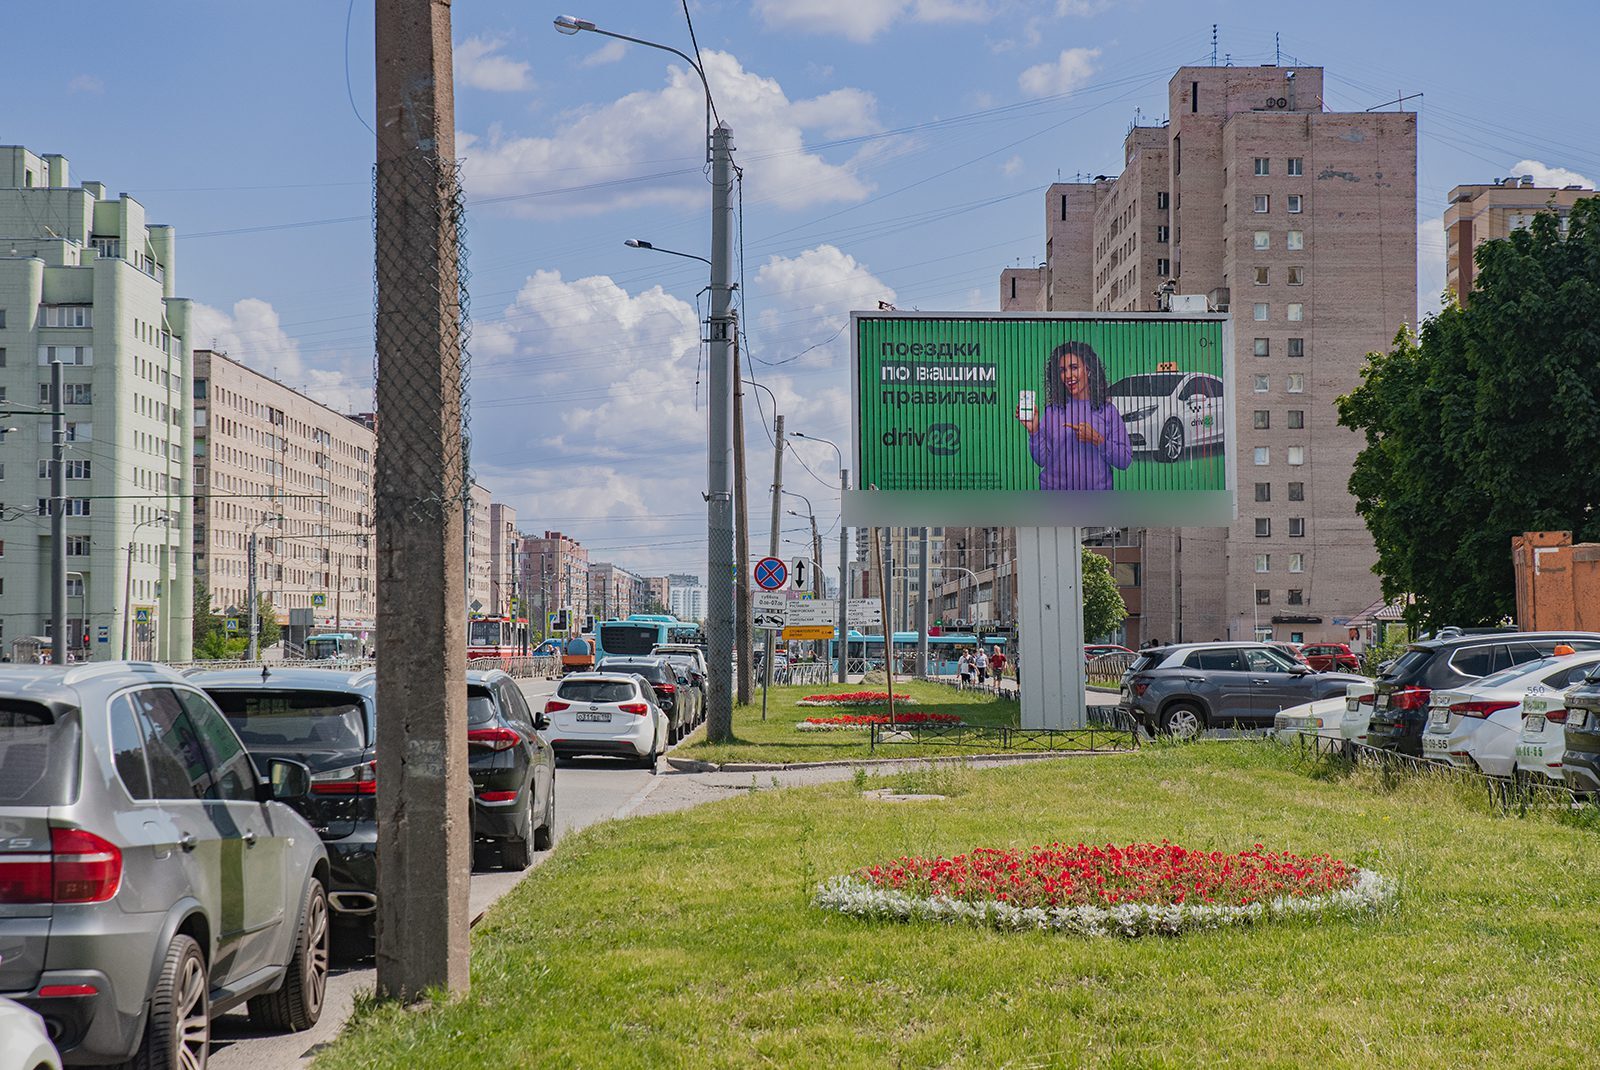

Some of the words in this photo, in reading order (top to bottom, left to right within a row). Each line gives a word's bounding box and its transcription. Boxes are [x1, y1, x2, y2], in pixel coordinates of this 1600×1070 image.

[1200, 337, 1214, 348] 0+
[881, 342, 980, 359] поездки
[881, 366, 910, 380] по
[916, 366, 995, 381] вашим
[882, 390, 997, 409] правилам
[1527, 686, 1545, 694] 560
